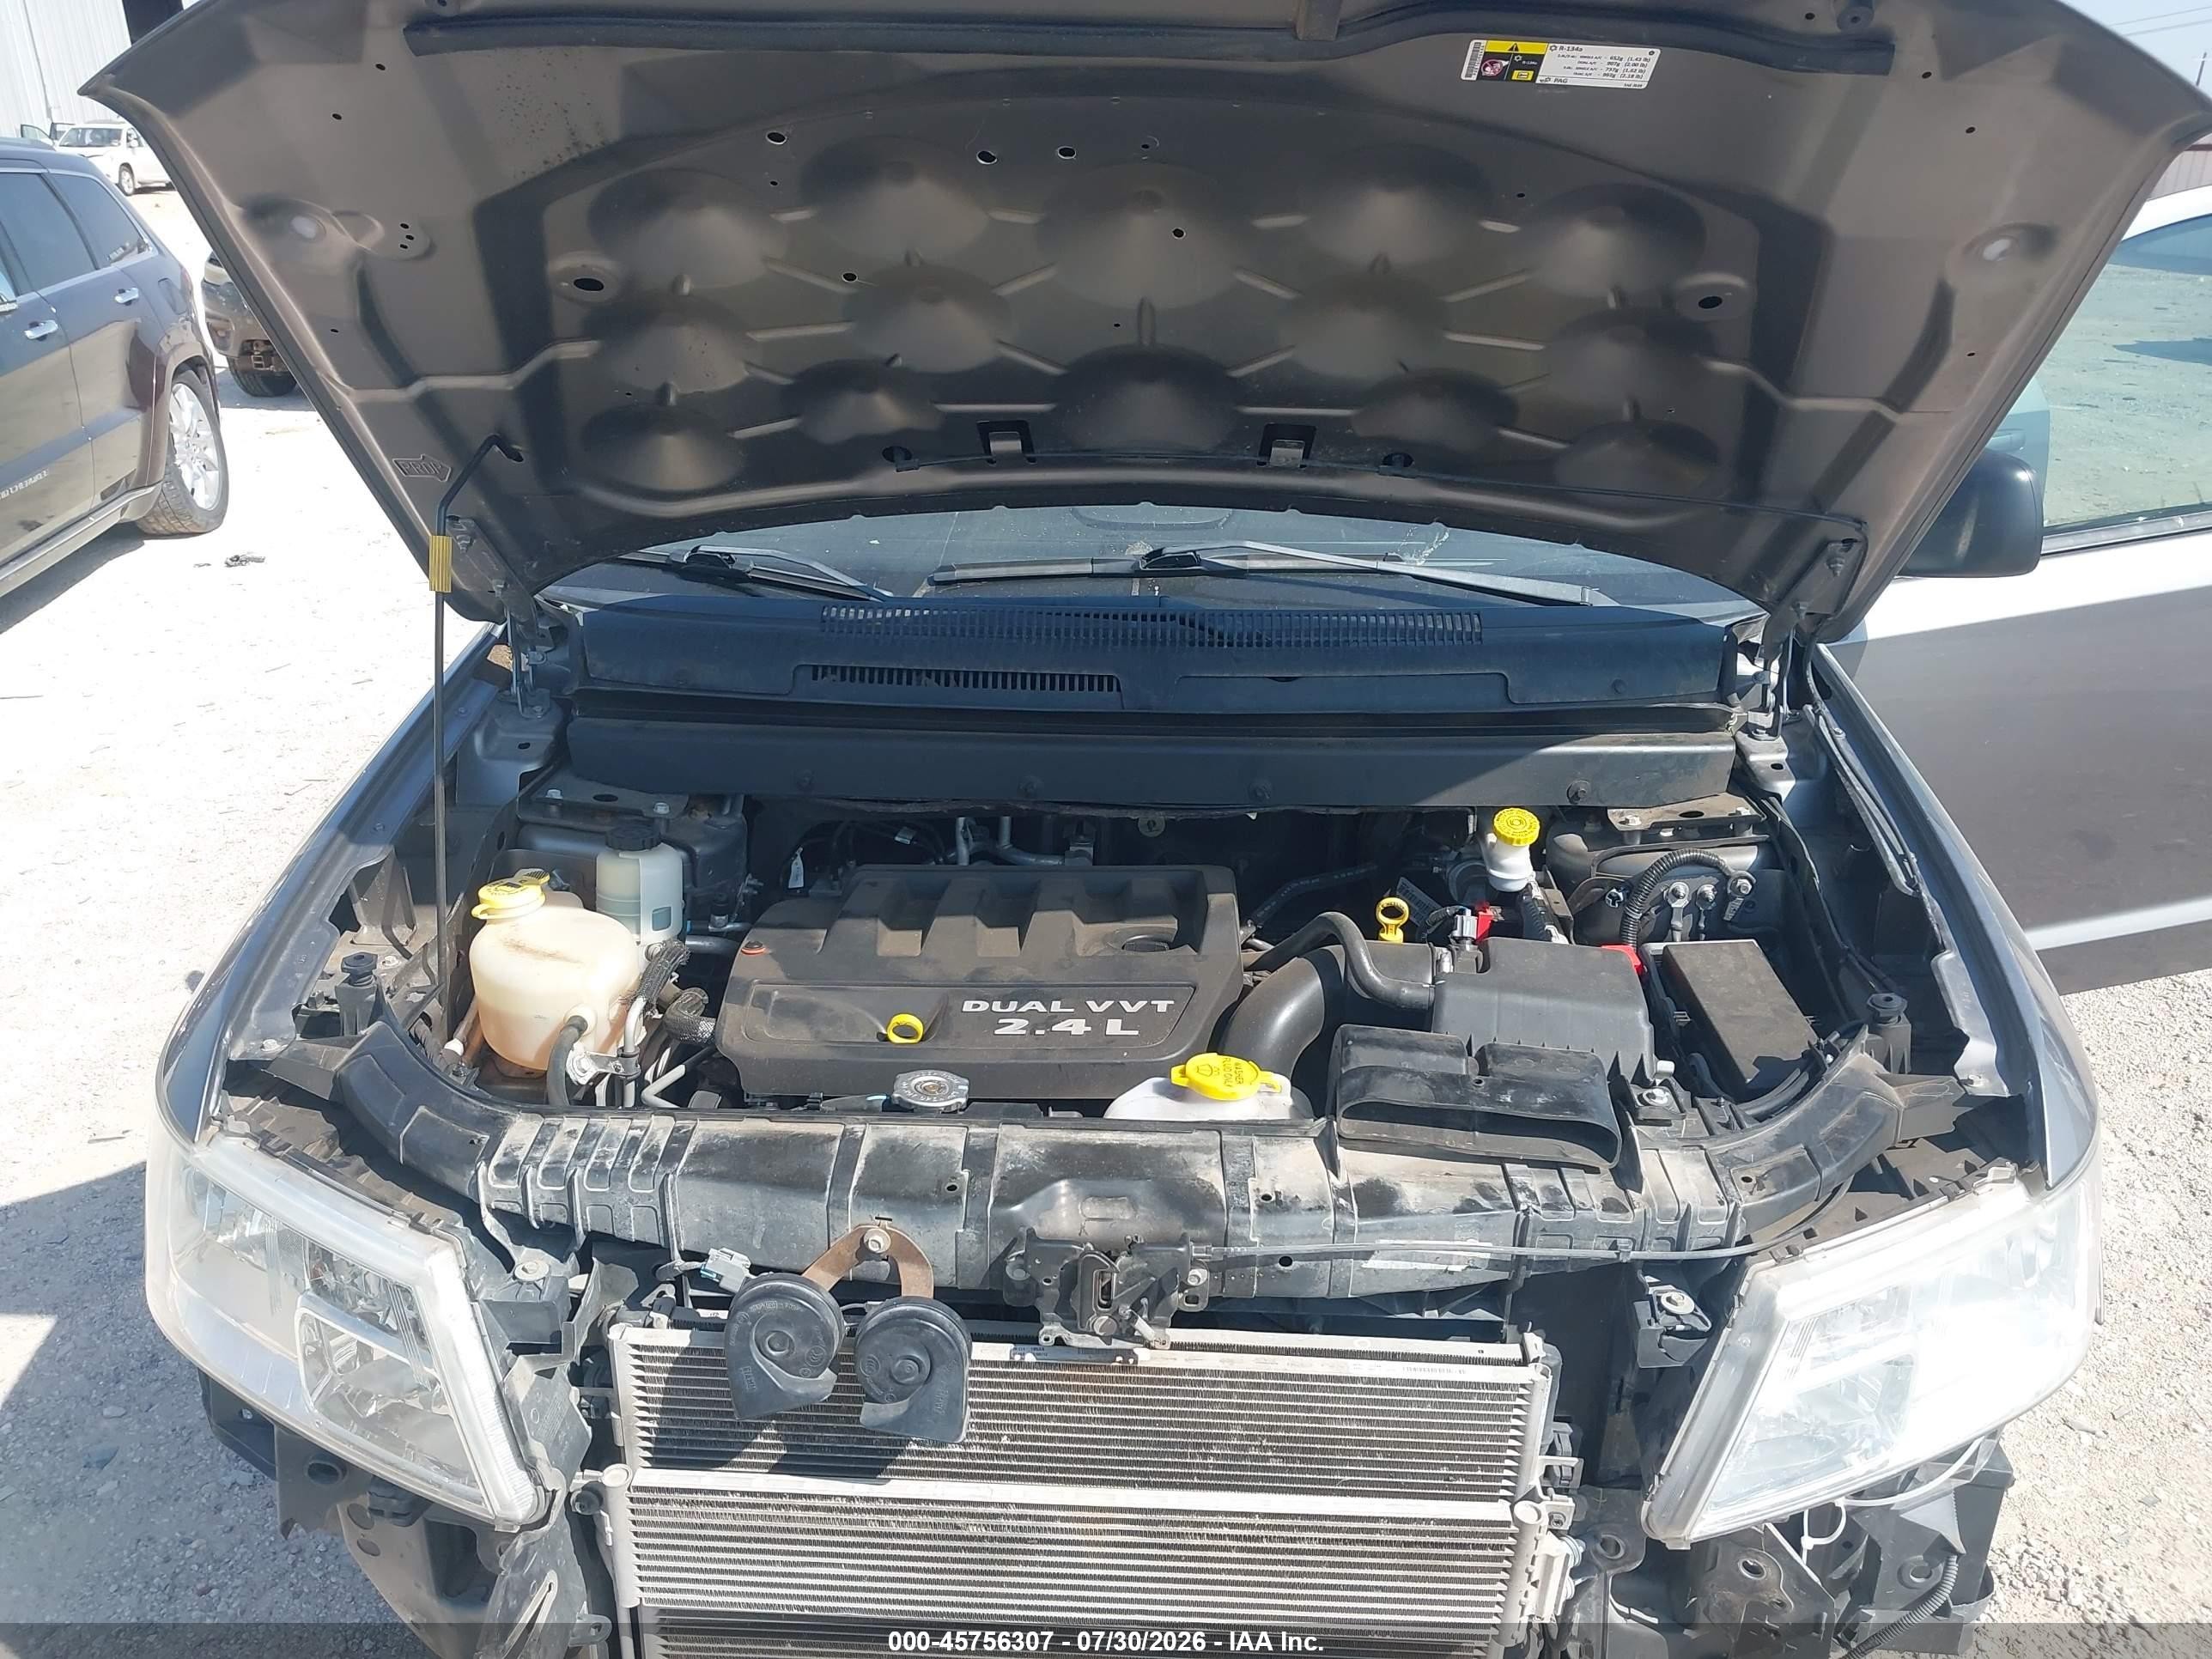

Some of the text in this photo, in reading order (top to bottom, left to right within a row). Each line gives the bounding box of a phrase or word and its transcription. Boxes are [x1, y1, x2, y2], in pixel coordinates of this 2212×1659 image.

[961, 1000, 1176, 1013] DUAL VVT
[994, 1018, 1139, 1036] 2.4 L
[1234, 1061, 1244, 1085] WASHER
